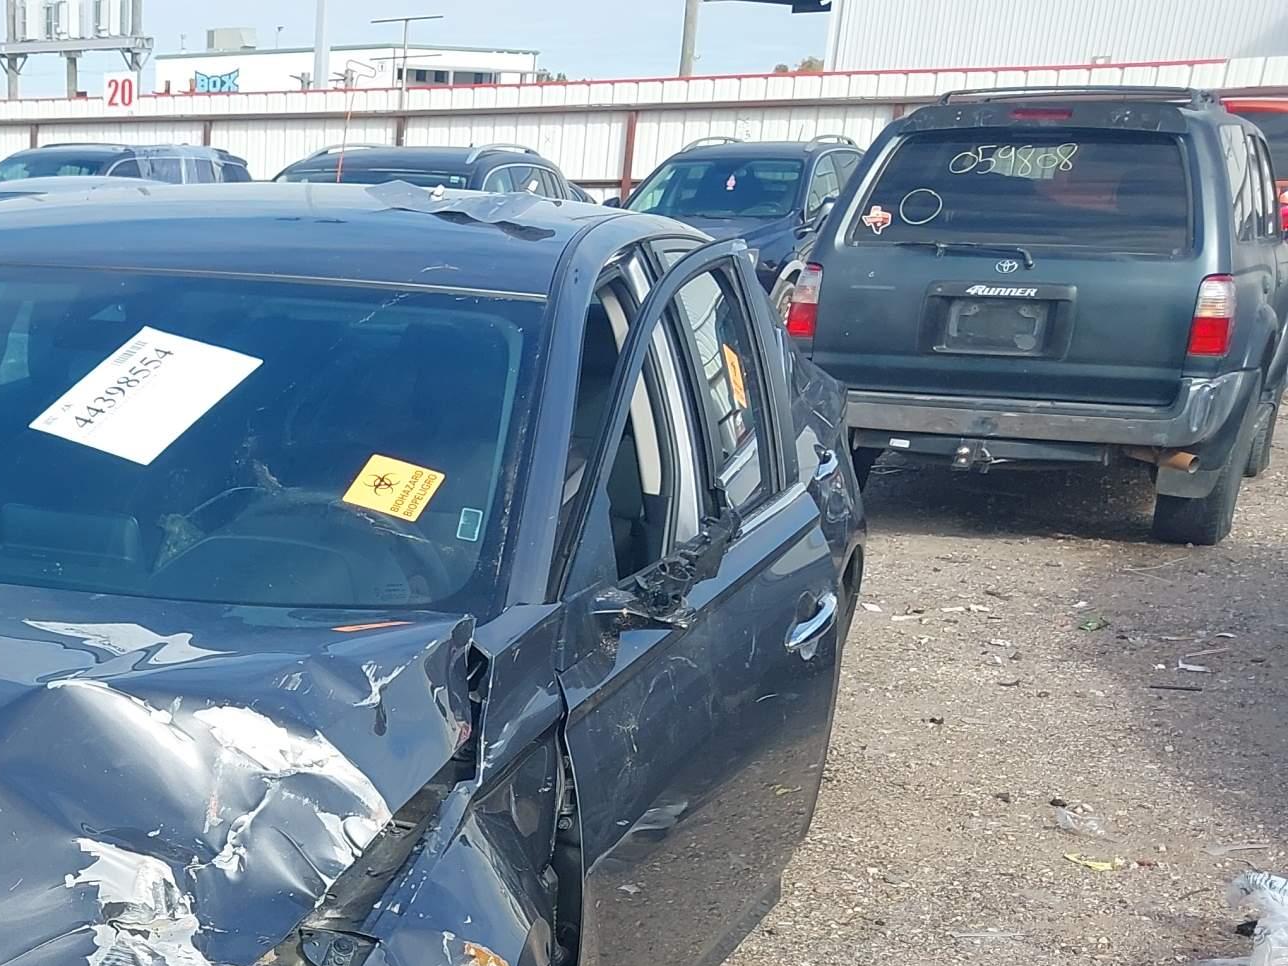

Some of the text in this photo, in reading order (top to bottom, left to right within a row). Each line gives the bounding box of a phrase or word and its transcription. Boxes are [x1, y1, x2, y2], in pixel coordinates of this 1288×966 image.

[107, 79, 133, 106] 20
[195, 69, 239, 93] BOX
[949, 143, 1078, 175] 059808
[74, 347, 174, 429] 44398554
[390, 470, 424, 512] BIOHAZARD
[403, 474, 438, 517] BIOPELIGRO
